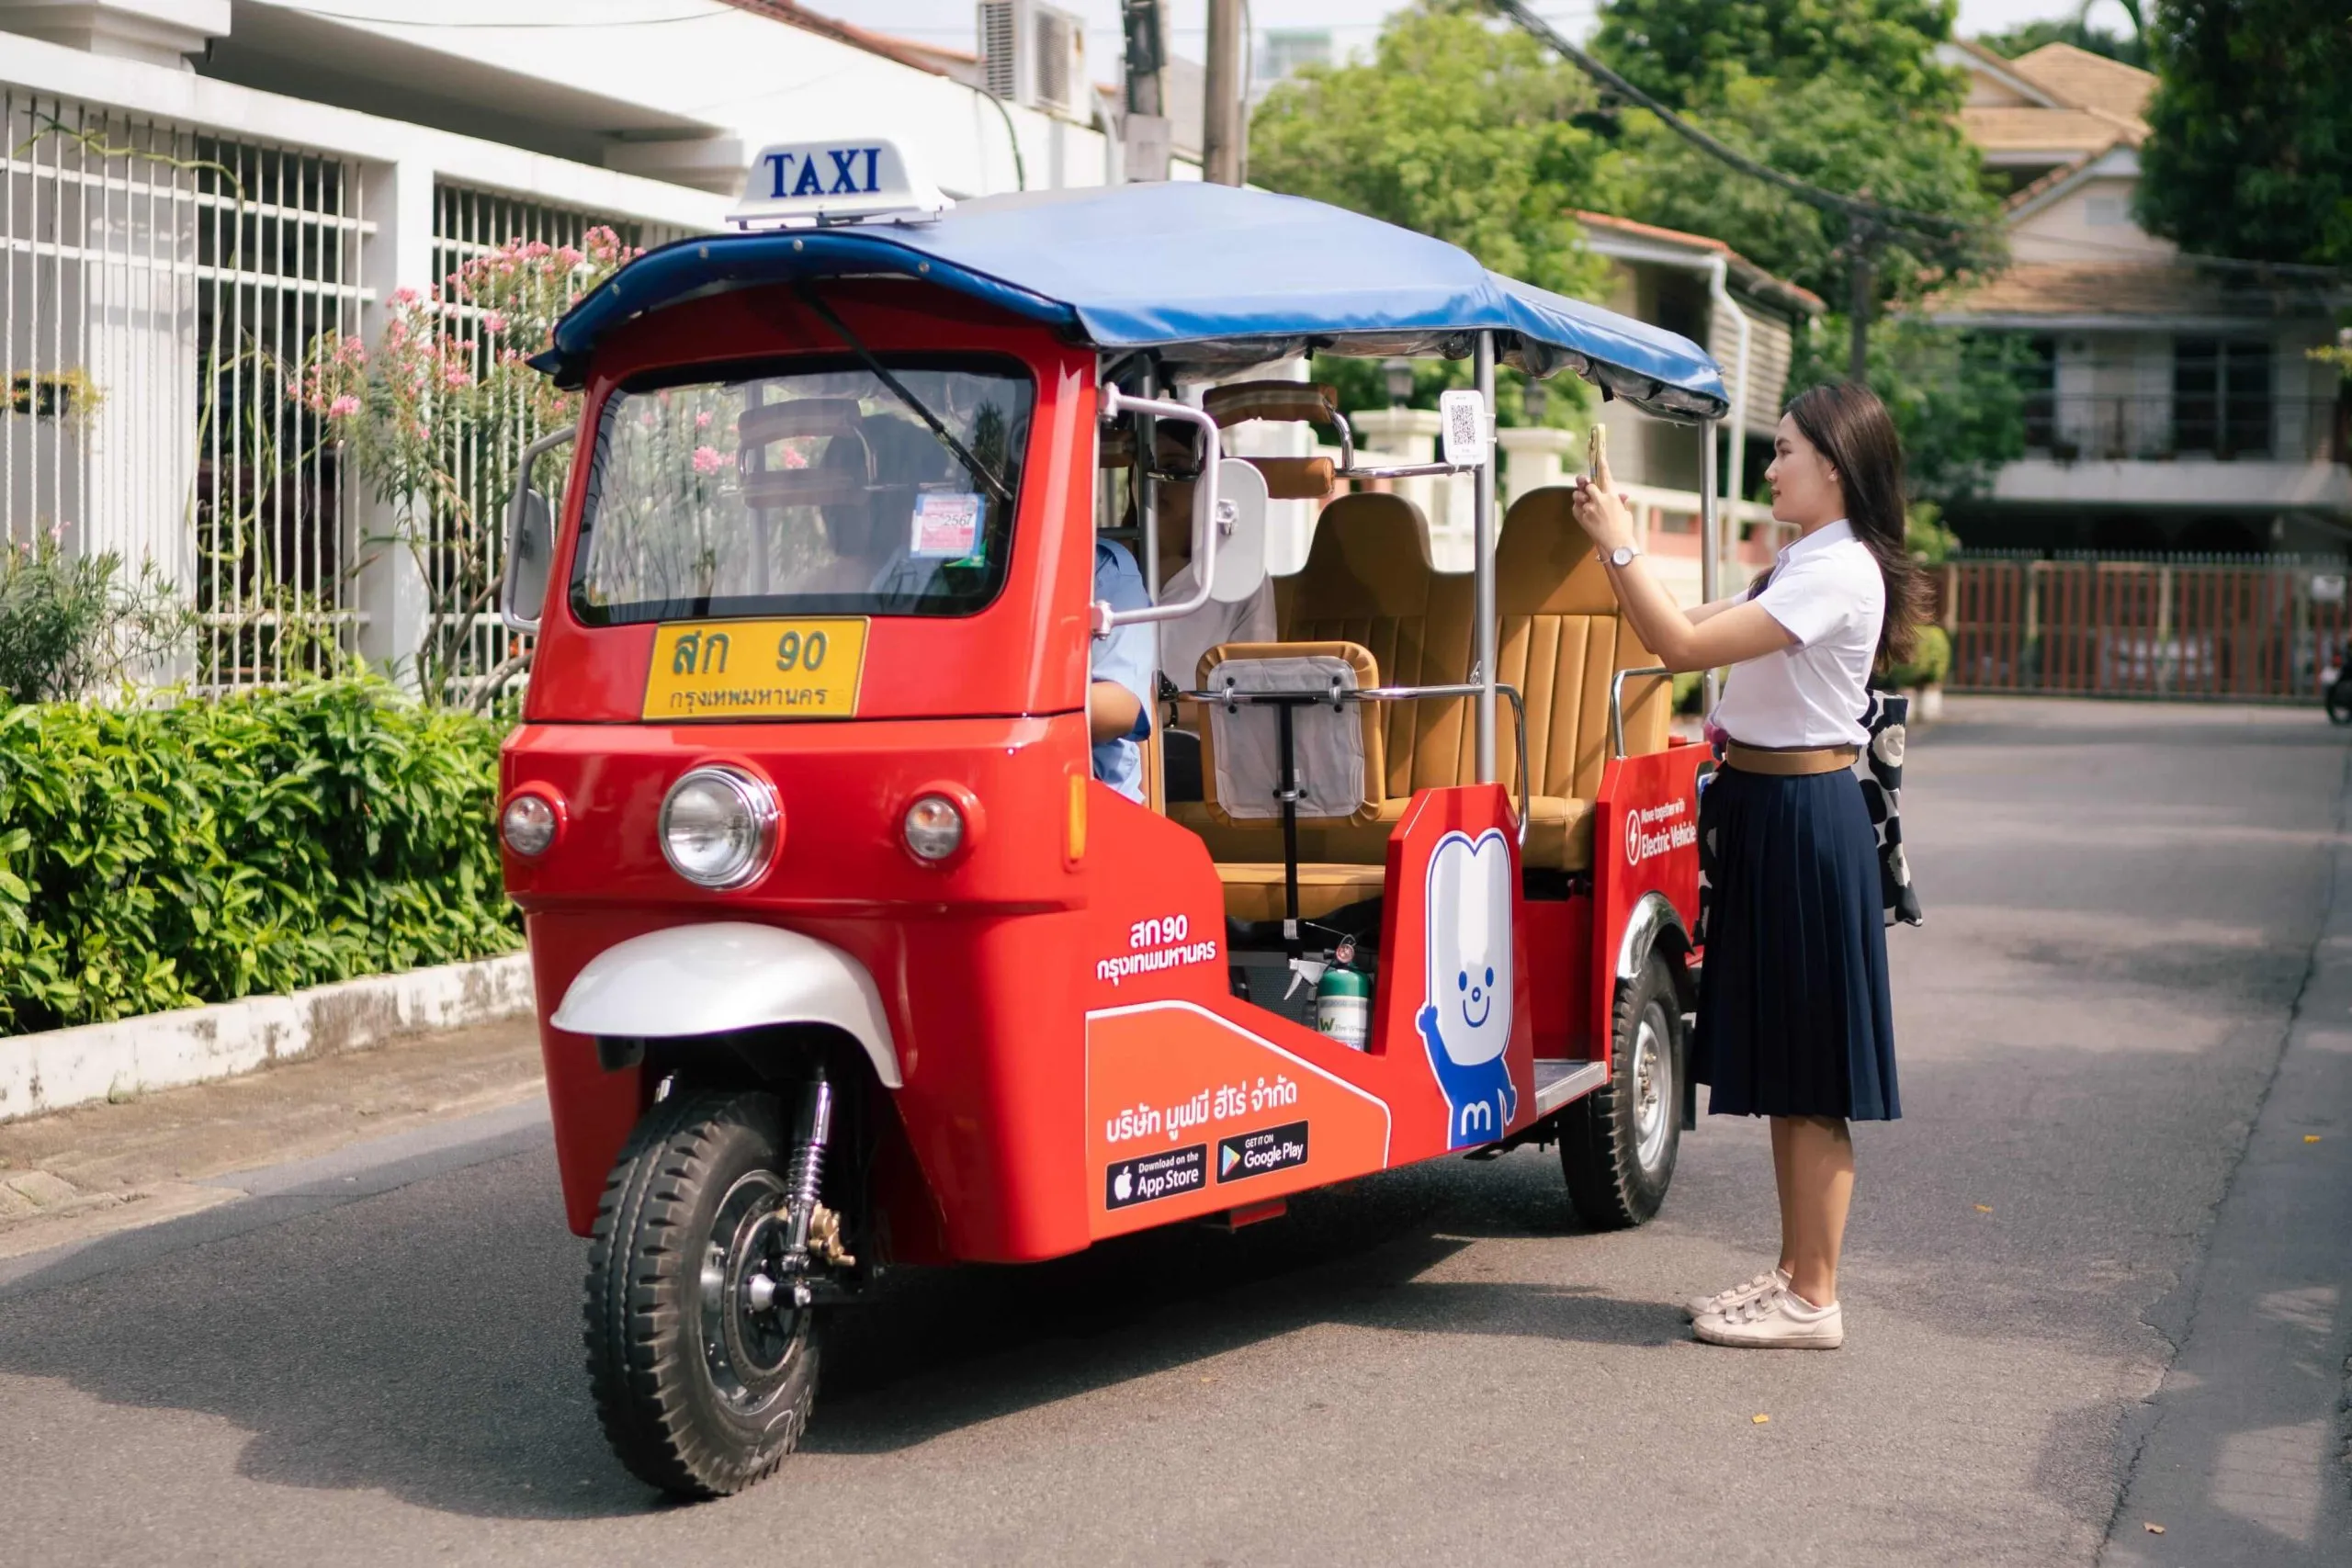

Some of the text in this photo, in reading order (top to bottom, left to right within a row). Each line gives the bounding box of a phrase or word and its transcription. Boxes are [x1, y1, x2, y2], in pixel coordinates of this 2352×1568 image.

[763, 148, 881, 197] TAXI
[943, 513, 973, 526] 2567
[673, 630, 828, 675] สก 90
[670, 688, 828, 714] กรุงเทพมหานคร
[1642, 820, 1697, 859] Electric Vehicle
[1096, 940, 1216, 987] กรุงเทพมหานคร
[1106, 1074, 1297, 1143] บริษัท มูฟมี ฮีโร่ จำกัด
[1244, 1141, 1304, 1168] Google Play
[1245, 1134, 1274, 1148] GET IT ON
[1138, 1152, 1199, 1174] Download on the
[1137, 1168, 1199, 1198] App Store
